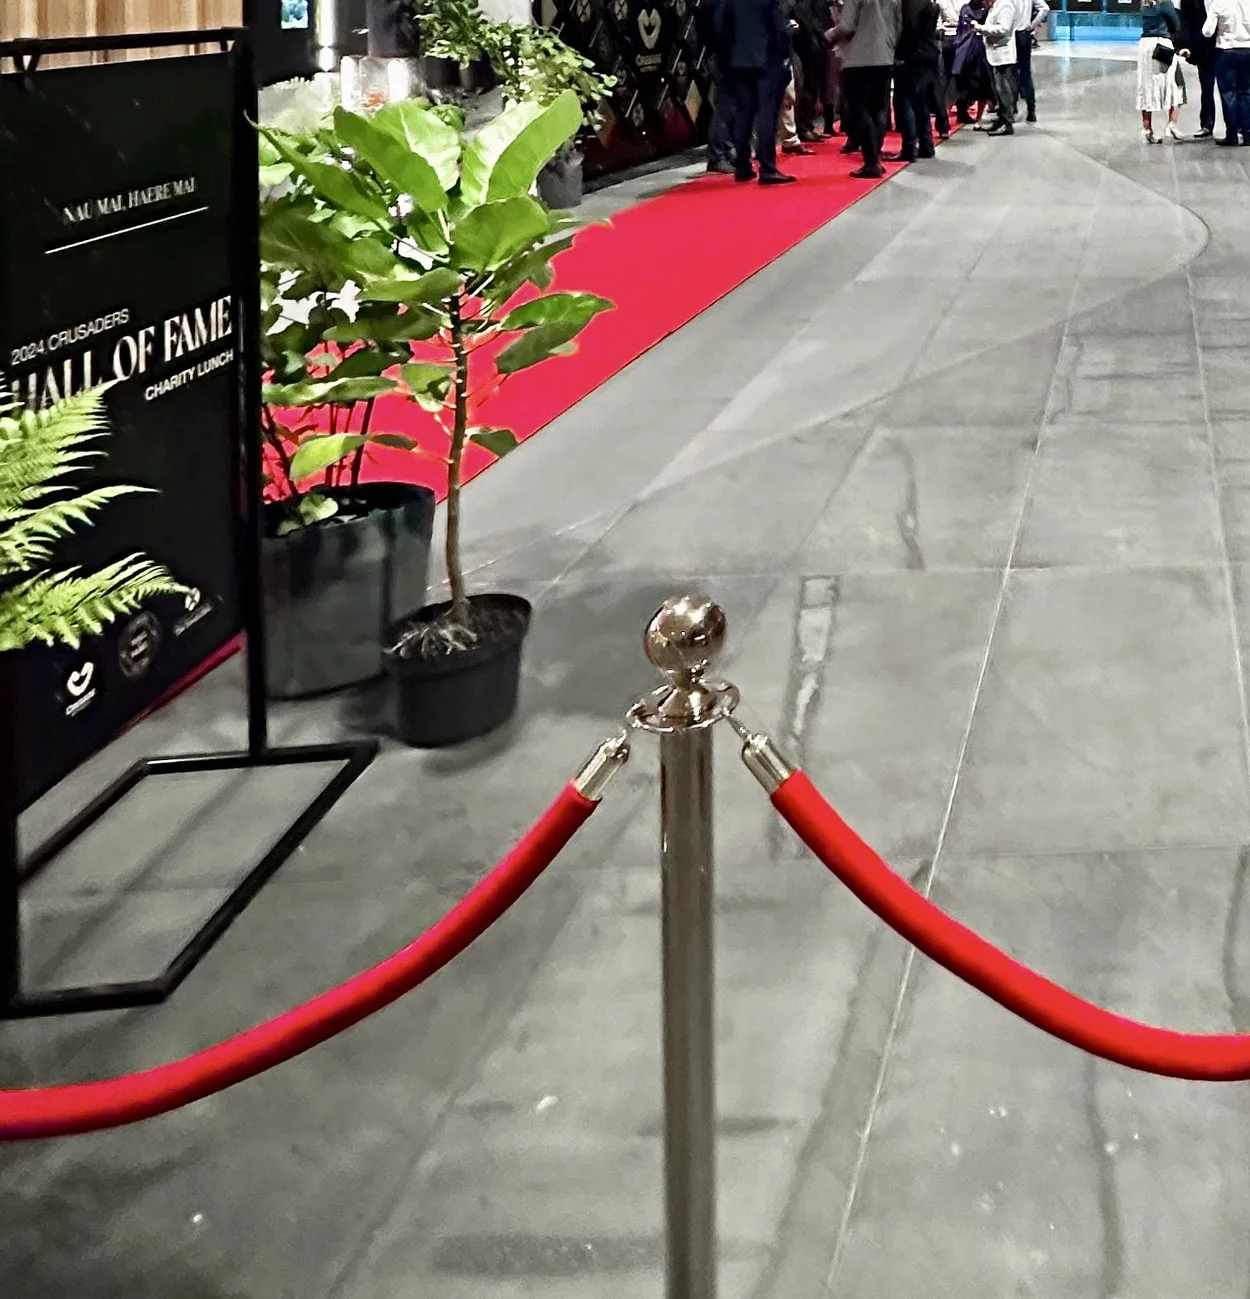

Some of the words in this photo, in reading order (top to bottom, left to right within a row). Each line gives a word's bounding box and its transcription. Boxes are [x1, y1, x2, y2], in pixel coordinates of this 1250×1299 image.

[11, 339, 45, 366] 2024
[47, 308, 129, 351] CRUSADERS
[11, 350, 103, 413] HALL
[112, 325, 155, 381] OF
[164, 295, 232, 363] FAME
[144, 366, 196, 401] CHARITY
[196, 348, 234, 377] LUNCH
